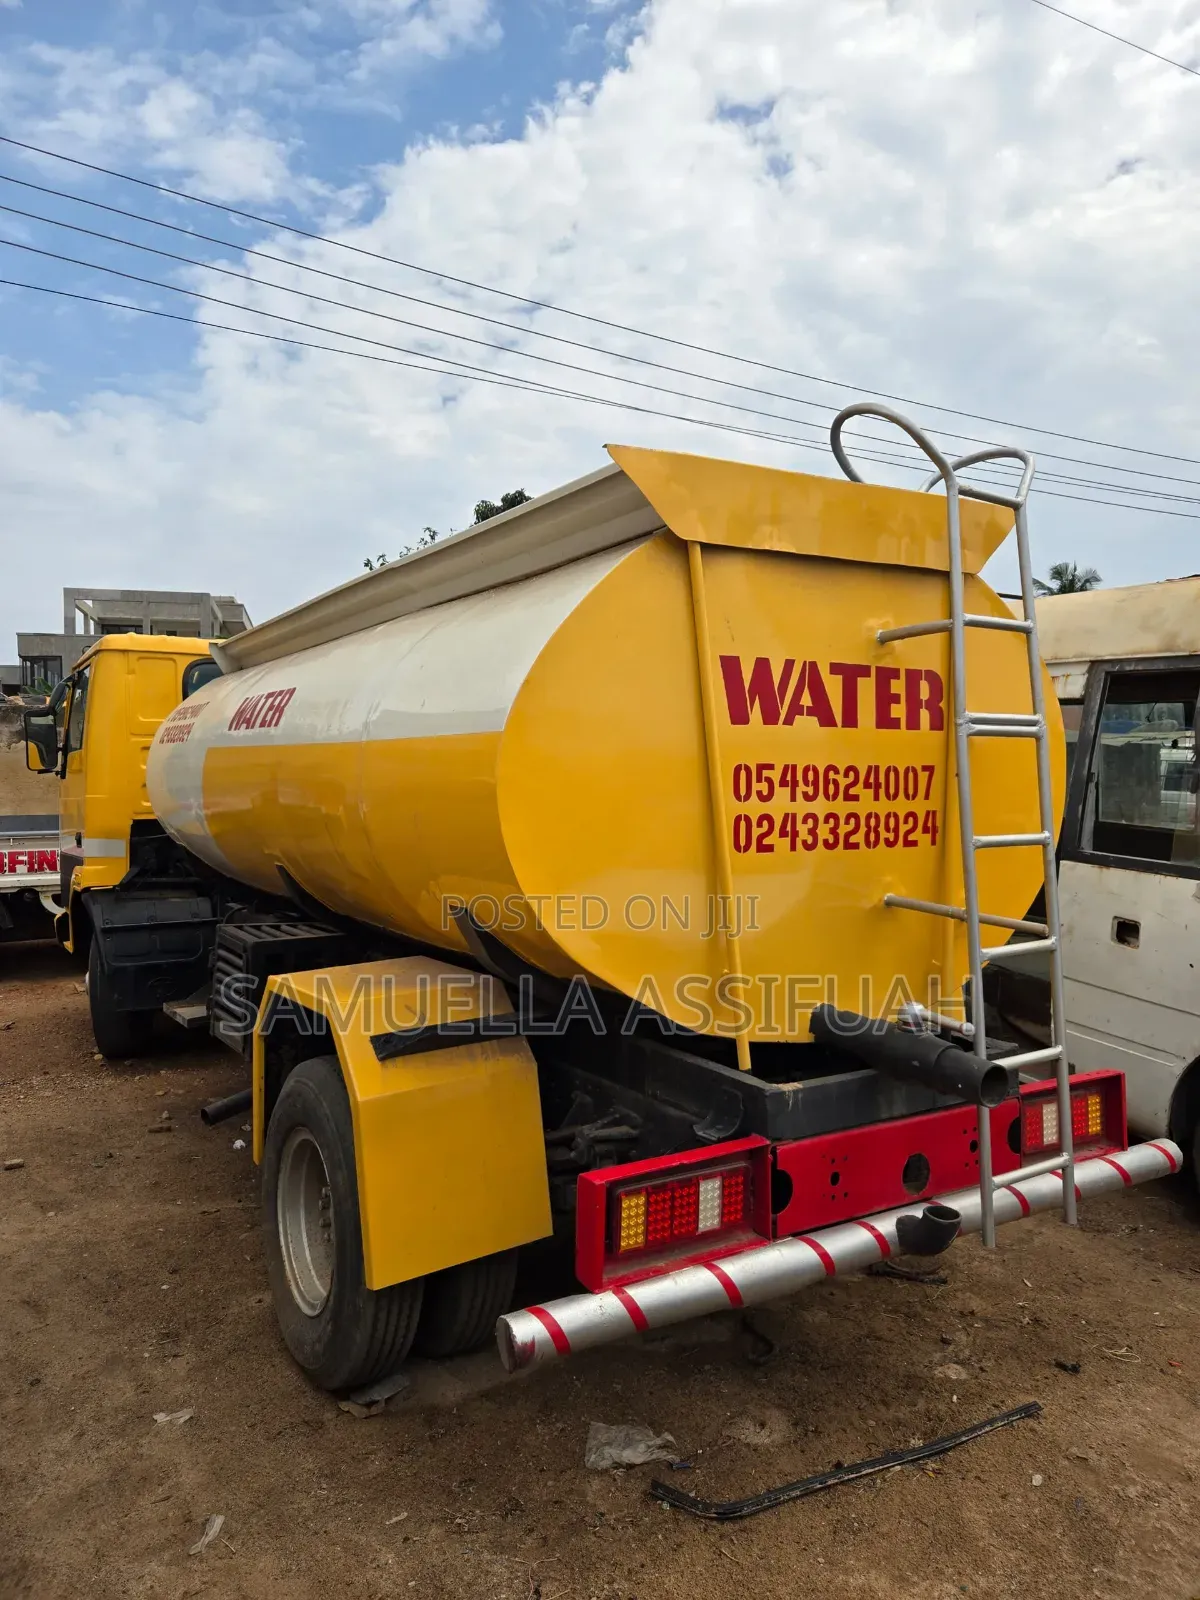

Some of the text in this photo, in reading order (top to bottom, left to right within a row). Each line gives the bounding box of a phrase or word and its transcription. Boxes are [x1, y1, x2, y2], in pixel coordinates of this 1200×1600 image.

[228, 687, 297, 731] WATER
[719, 655, 945, 731] WATER
[733, 763, 936, 803] 0549624007
[733, 810, 939, 853] 0243328924
[0, 849, 59, 874] FIN
